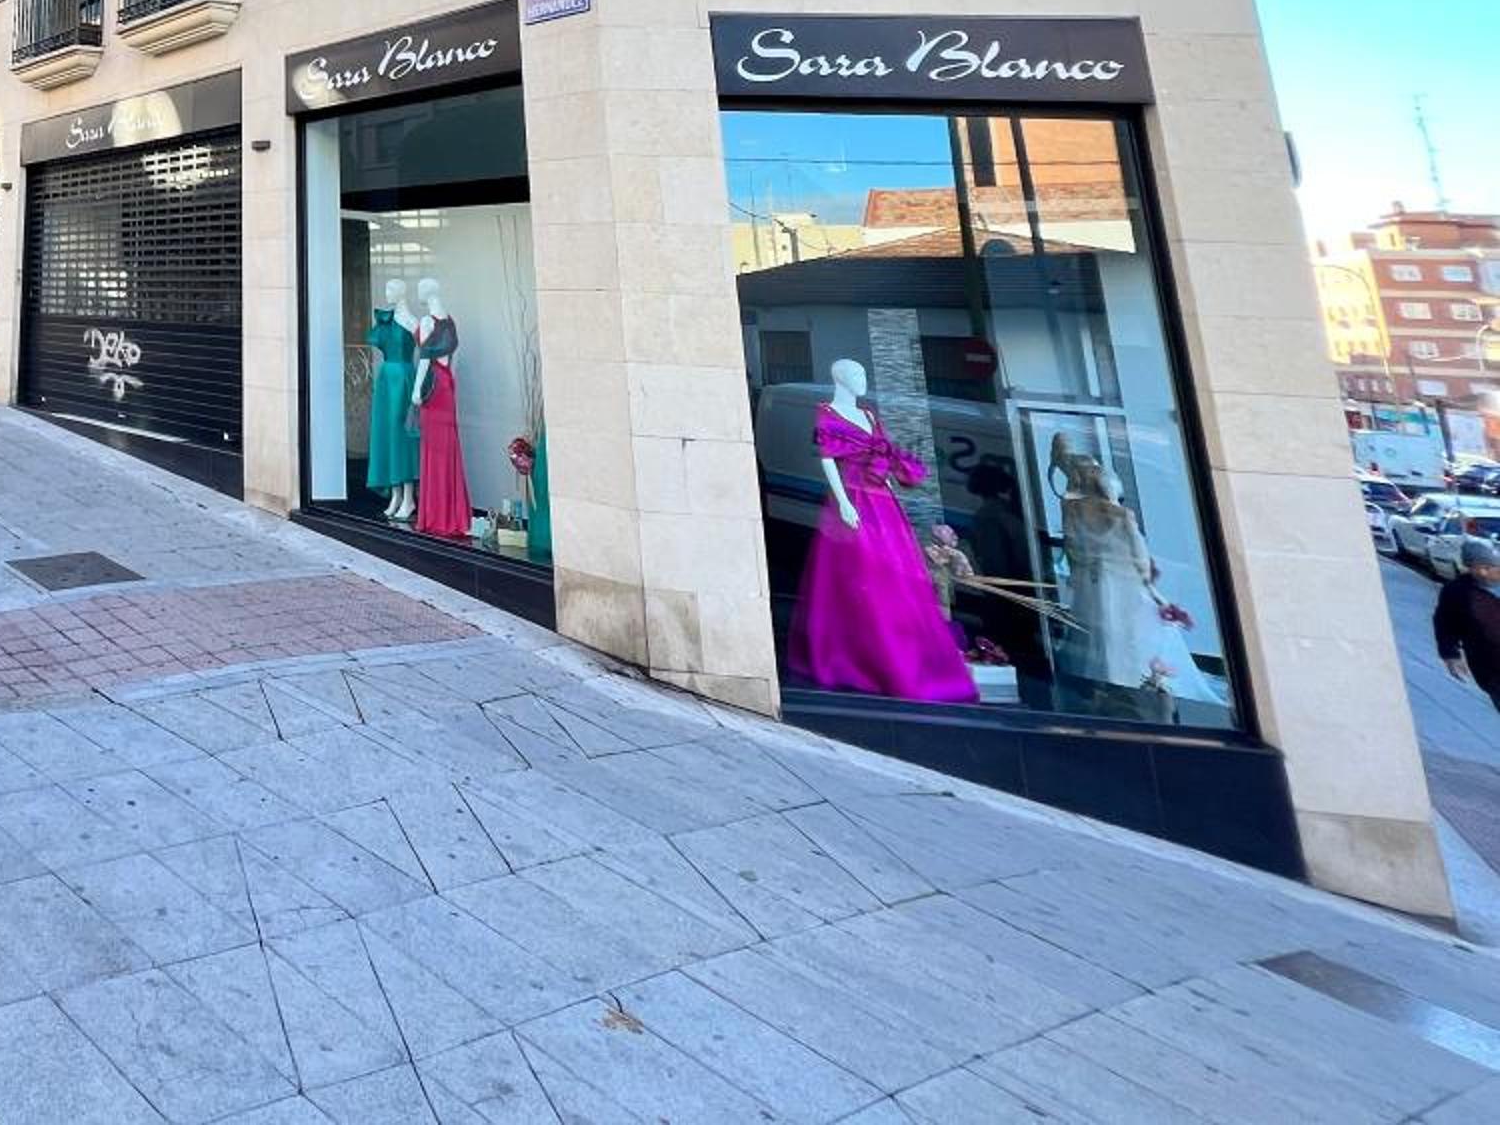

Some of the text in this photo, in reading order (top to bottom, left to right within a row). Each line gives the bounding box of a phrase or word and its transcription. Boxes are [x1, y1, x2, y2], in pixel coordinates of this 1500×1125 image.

[300, 36, 498, 99] Sara Blanco
[737, 28, 1124, 82] Sara Blanco
[65, 116, 105, 148] Sara
